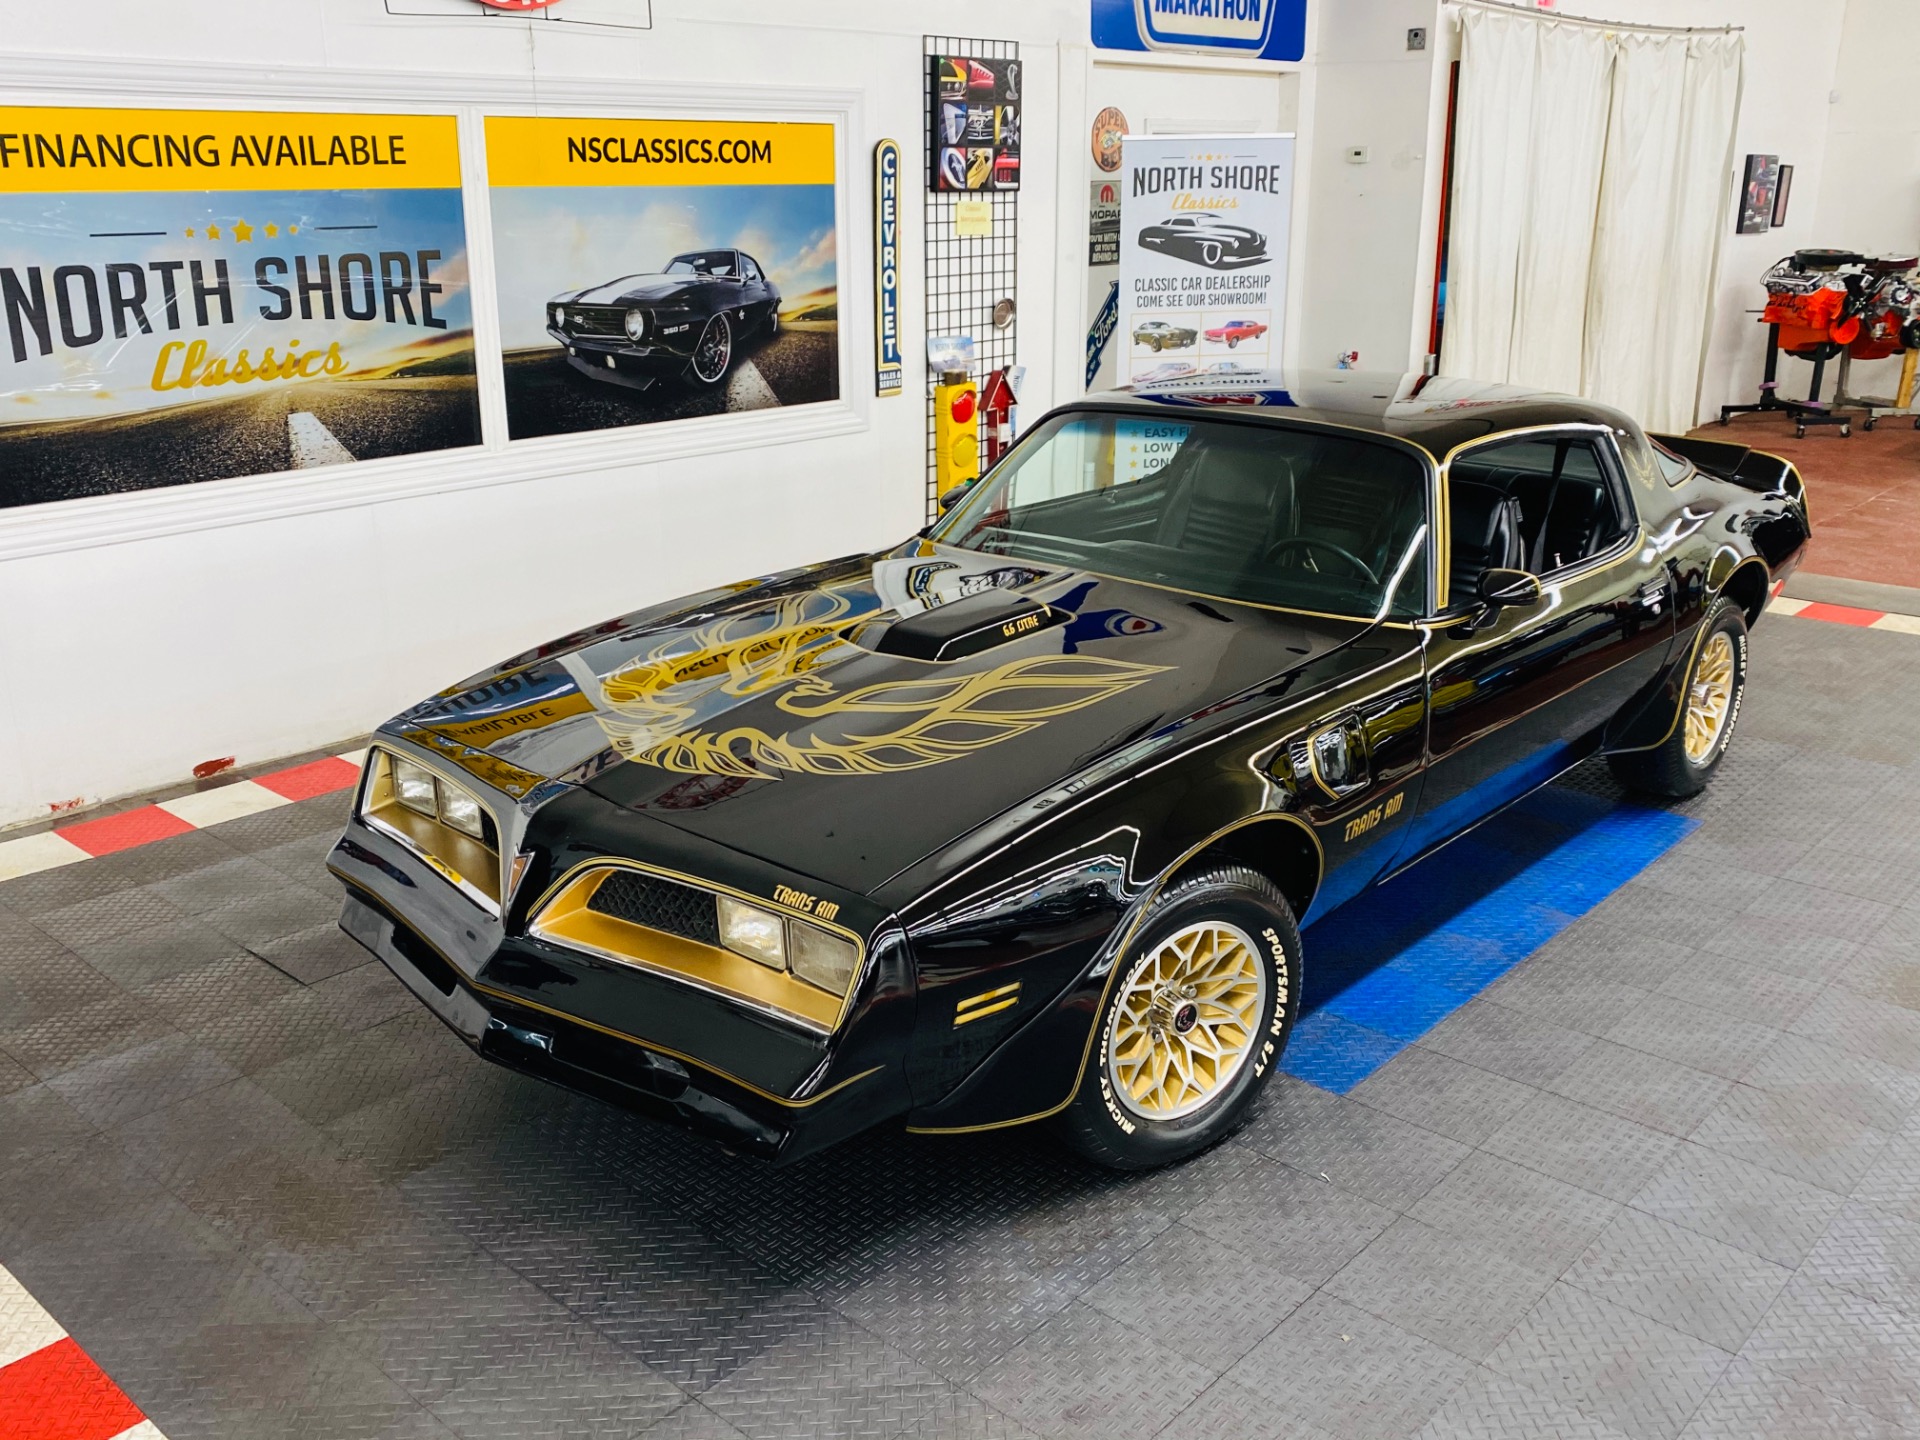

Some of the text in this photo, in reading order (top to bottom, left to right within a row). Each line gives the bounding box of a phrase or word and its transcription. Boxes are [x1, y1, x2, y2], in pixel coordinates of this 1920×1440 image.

[1155, 0, 1260, 21] MARATHON
[0, 133, 407, 168] FINANCING AVAILABLE
[567, 136, 772, 164] NSCLASSICS.COM
[1132, 165, 1280, 197] NORTH SHORE
[1171, 193, 1240, 210] Classics
[882, 152, 897, 359] CHEVROLET
[1134, 275, 1271, 292] CLASSIC CAR DEALERSHIP
[1136, 292, 1267, 308] COME SEE OUR SHOWROOM!
[0, 249, 447, 362] NORTH SHORE
[1095, 302, 1119, 348] Ford
[151, 338, 350, 392] Classics
[1144, 427, 1176, 438] EASY
[1144, 443, 1173, 453] LOW
[1003, 614, 1039, 637] 6.6 LITRE
[1738, 634, 1747, 678] MICKEY
[1344, 792, 1404, 842] TRANS AM
[773, 884, 840, 920] TRANS AM
[1254, 927, 1289, 1078] SPORTSMAN S/T
[1100, 1076, 1136, 1135] MICKEY
